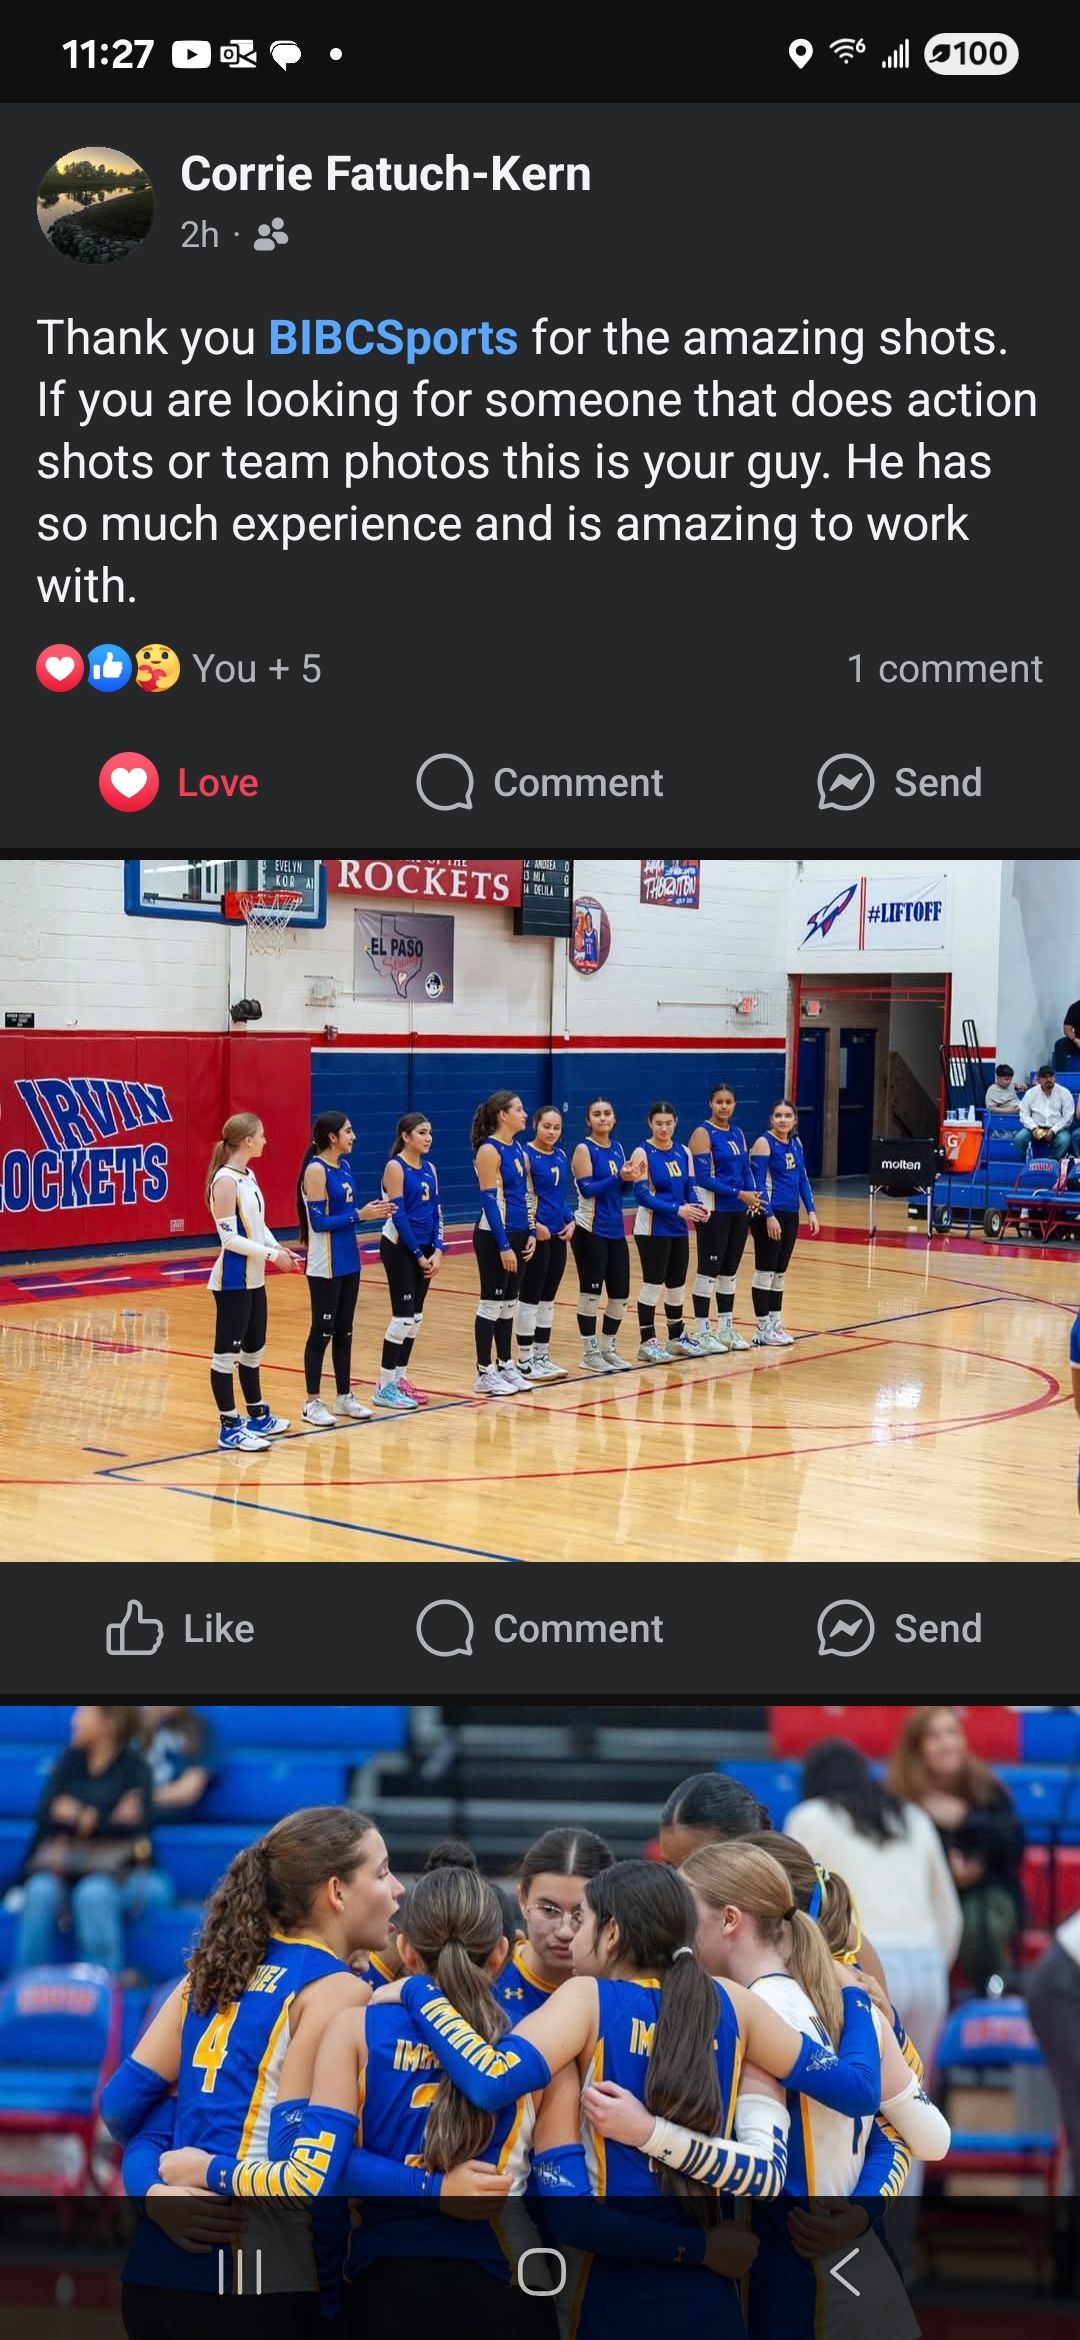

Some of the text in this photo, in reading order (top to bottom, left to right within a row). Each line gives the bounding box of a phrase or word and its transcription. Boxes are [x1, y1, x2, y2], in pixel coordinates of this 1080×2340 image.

[62, 39, 154, 68] 11:27
[952, 42, 1008, 66] 100
[182, 154, 590, 191] Corrie Fatuch-Kern
[181, 220, 218, 247] 2h
[37, 317, 1006, 365] Thank you BIBCSports for the amazing shots.
[40, 379, 1036, 427] If you are looking for someone that does action
[38, 442, 991, 489] shots or team photos this is your guy. He has
[38, 504, 970, 550] so much experience and is amazing to work
[37, 566, 135, 603] with.
[192, 654, 321, 683] You + 5
[848, 654, 1043, 683] 1 comment
[179, 768, 259, 797] Love
[495, 768, 663, 797] Comment
[895, 766, 981, 797] Send
[275, 860, 302, 873] EVELYN
[533, 871, 545, 883] MIA
[534, 860, 556, 871] ANDREA
[338, 860, 510, 901] ROCKETS
[533, 884, 554, 896] DELILA
[643, 875, 696, 900] THORNTON
[868, 901, 942, 923] #LIFTOFF
[371, 937, 423, 957] EL PASO
[14, 1077, 174, 1150] IRVIN
[728, 1140, 741, 1156] 11
[946, 1135, 958, 1147] G
[550, 1166, 560, 1186] 7
[664, 1161, 682, 1179] 10
[784, 1153, 796, 1170] 12
[882, 1160, 921, 1171] molten
[0, 1143, 168, 1212] OCKETS
[420, 1181, 430, 1202] 3
[254, 1191, 262, 1213] 1
[341, 1182, 353, 1203] 2
[186, 1612, 254, 1643] Like
[495, 1614, 663, 1643] Comment
[895, 1612, 981, 1643] Send
[192, 2002, 239, 2094] 4
